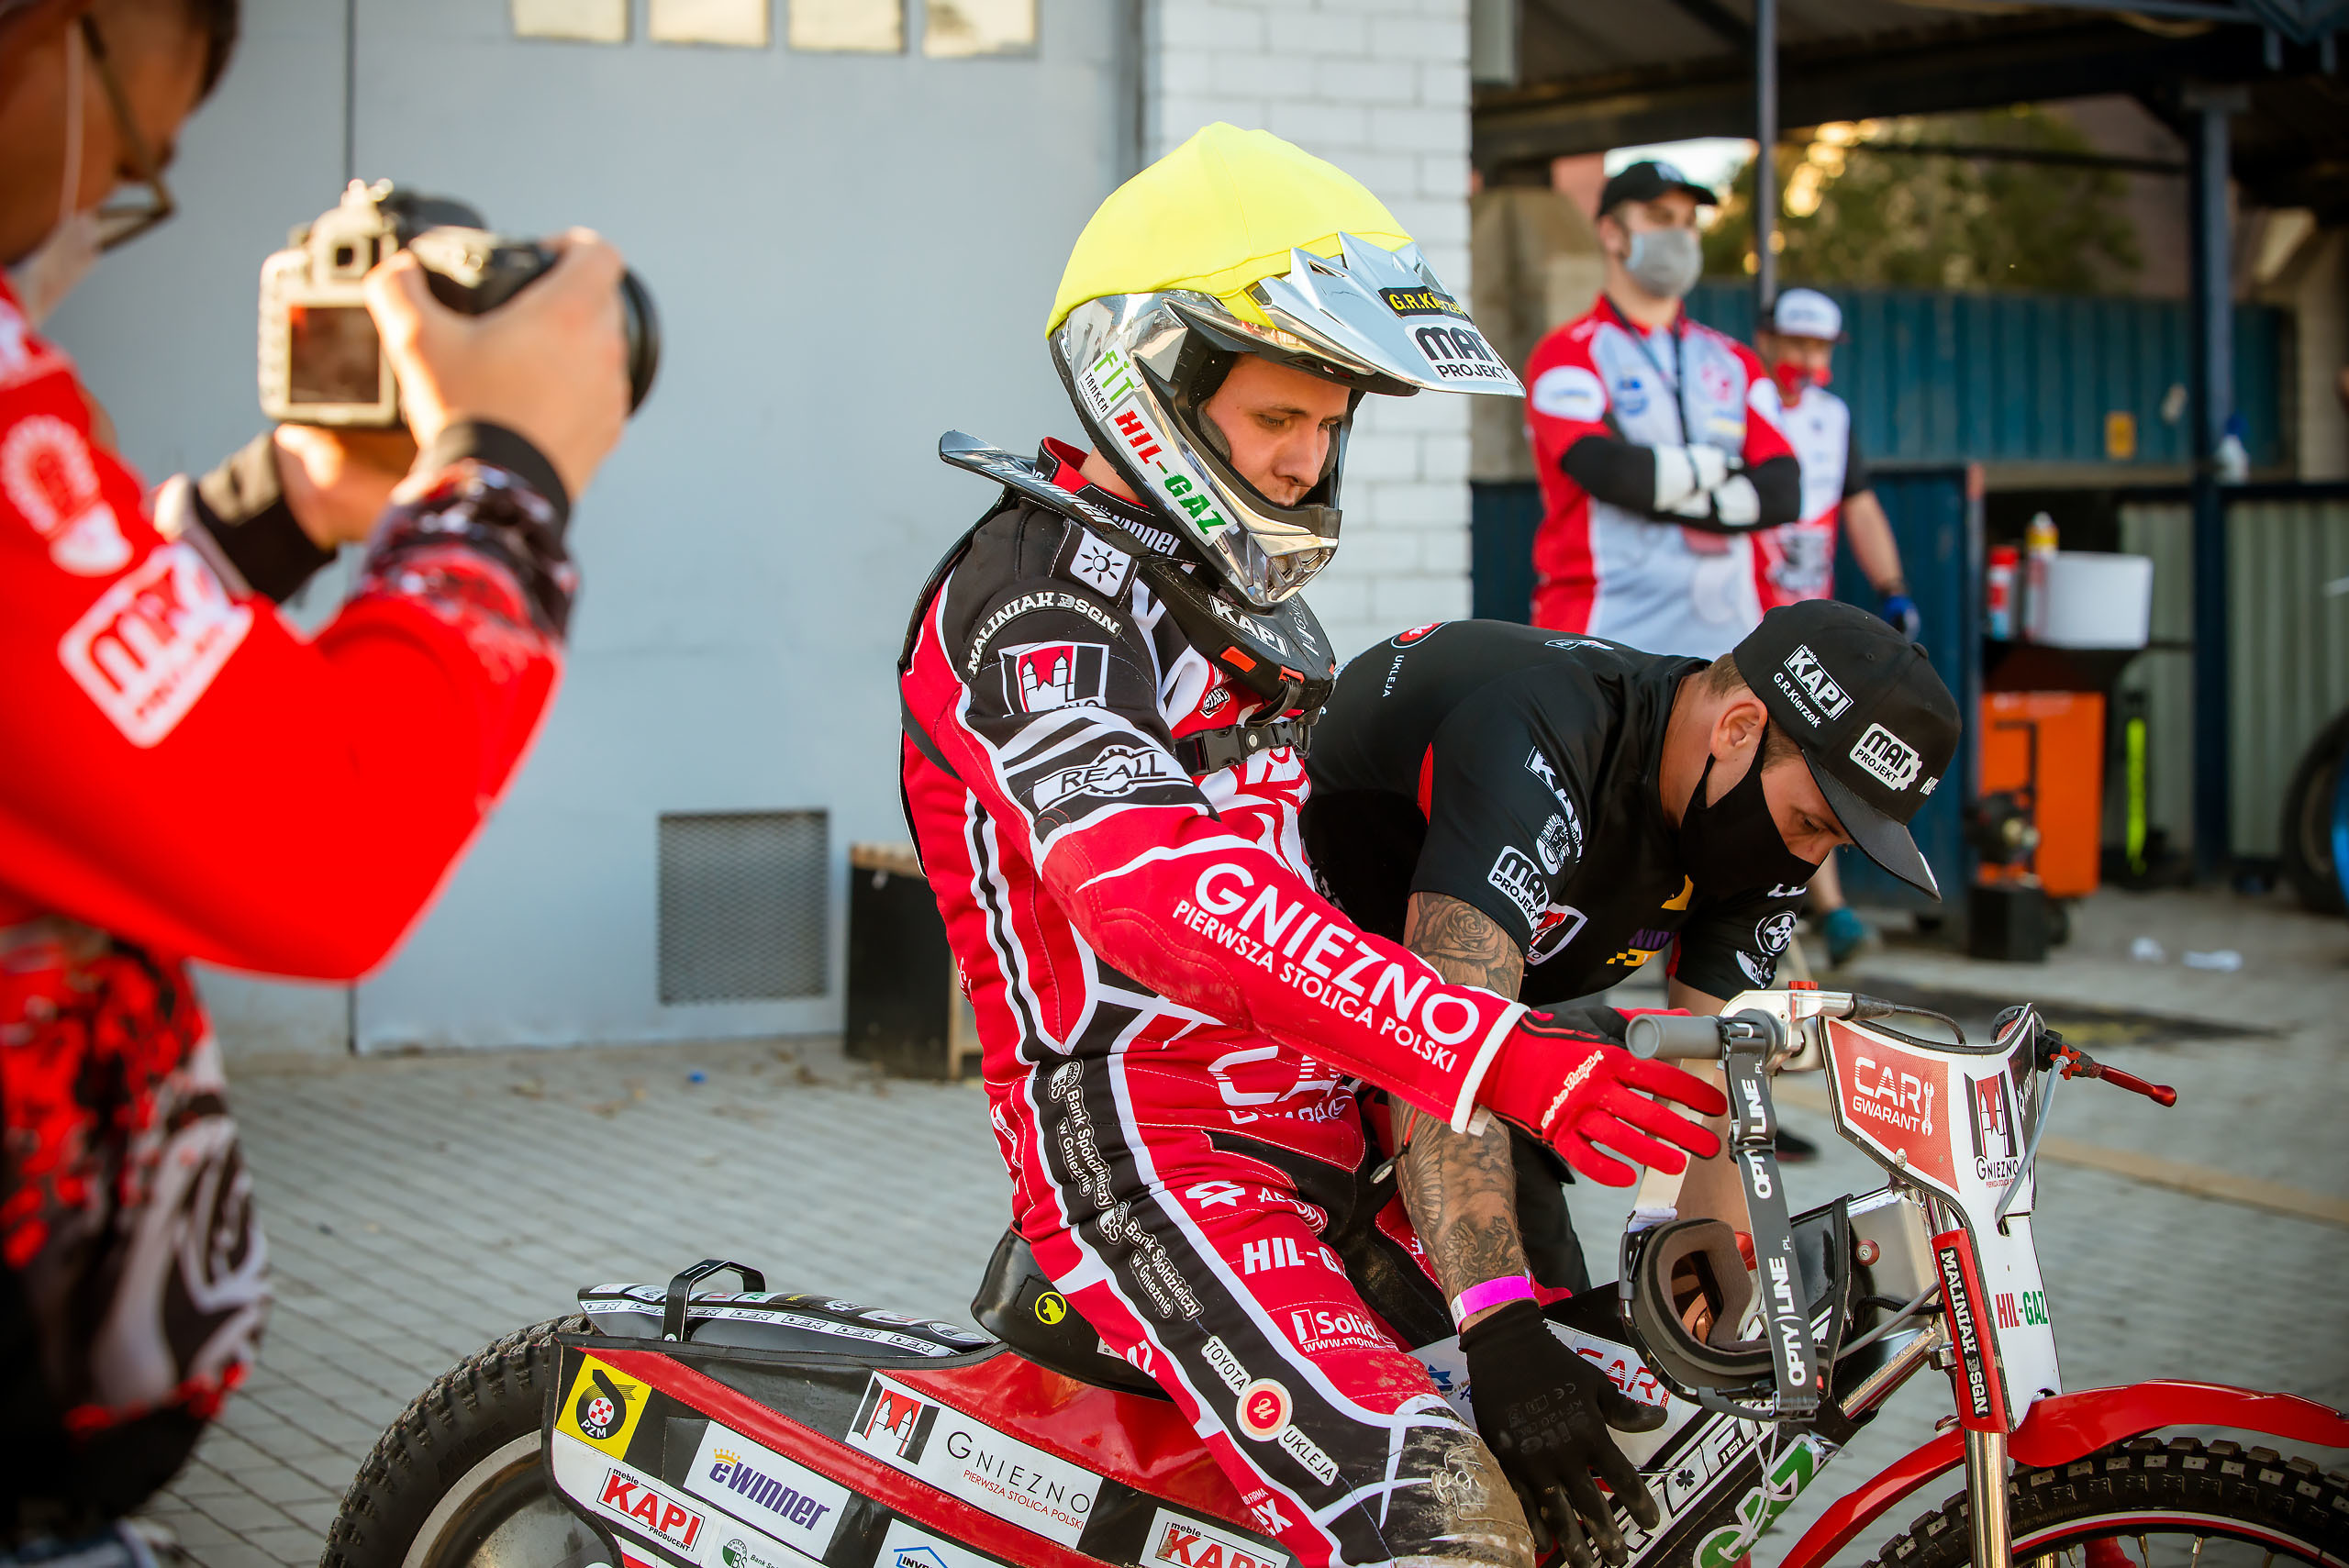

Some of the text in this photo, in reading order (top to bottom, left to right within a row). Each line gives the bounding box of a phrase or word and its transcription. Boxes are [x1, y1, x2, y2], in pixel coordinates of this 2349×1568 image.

[1415, 327, 1495, 362] MAT
[1084, 372, 1109, 413] TANKEN
[1094, 350, 1135, 403] FIT
[1435, 364, 1508, 380] PROJEKT
[1114, 407, 1228, 535] HIL-GAZ
[967, 592, 1120, 675] MALINIAK DSGN
[1213, 597, 1286, 655] KAPI
[1382, 654, 1405, 697] UKLEJA
[1787, 649, 1849, 717] KAPI
[1773, 672, 1821, 728] G.R.Kierzek
[1807, 691, 1835, 720] PRODUCENT
[1854, 749, 1898, 783] PROJEKT
[1862, 730, 1913, 772] MAT
[1061, 753, 1168, 794] REALL
[1497, 851, 1548, 910] MA
[1196, 863, 1480, 1045] GNIEZNO
[1173, 900, 1458, 1073] PIERWSZA STOLICA POLSKI
[1854, 1057, 1921, 1115] CAR
[1853, 1095, 1920, 1133] GWARANT
[1066, 1090, 1086, 1128] Bank
[1077, 1129, 1113, 1207] Spółdzielczy
[1976, 1157, 2020, 1181] GNIEZNO
[1125, 1221, 1154, 1251] Bank
[1241, 1237, 1351, 1281] HIL-G
[1995, 1290, 2049, 1329] HIL-GAZ
[1941, 1250, 1989, 1415] MALINIAK DSGN
[581, 1418, 607, 1439] PZM
[1206, 1340, 1247, 1391] TOYOTA
[1283, 1429, 1333, 1481] UKLEJA
[613, 1469, 640, 1485] meble
[947, 1431, 1090, 1513] GNIEZNO
[602, 1474, 701, 1546] KAPI
[963, 1470, 1085, 1530] PIERWSZA STOLICA POLSKI
[649, 1526, 690, 1551] PRODUCENT
[1171, 1522, 1202, 1538] meble
[750, 1553, 766, 1567] Bank
